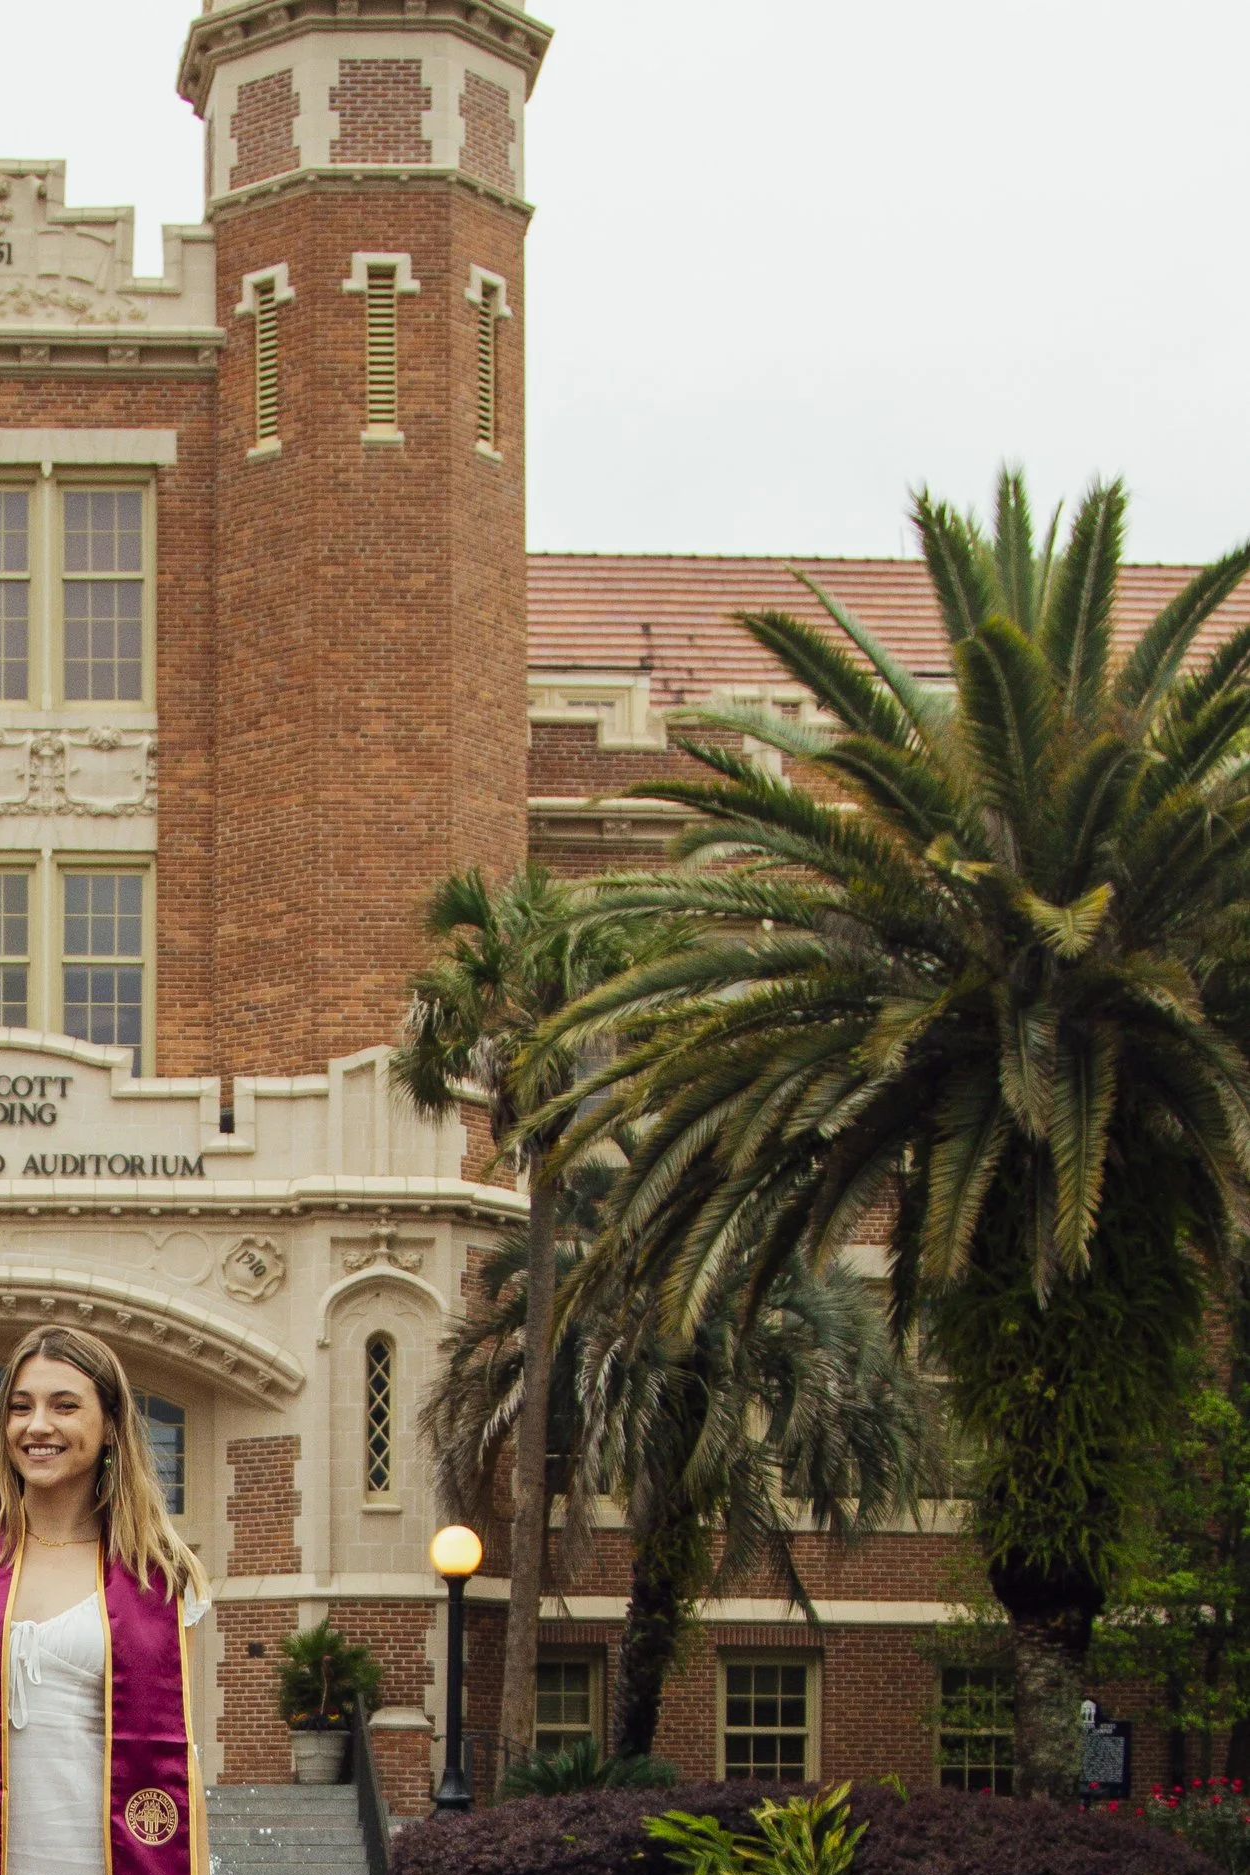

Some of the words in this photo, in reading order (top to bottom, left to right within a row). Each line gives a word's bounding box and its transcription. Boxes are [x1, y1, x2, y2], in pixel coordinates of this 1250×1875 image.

[22, 1154, 206, 1177] AUDITORIUM
[235, 1250, 267, 1277] 1910
[138, 1791, 158, 1801] STATE
